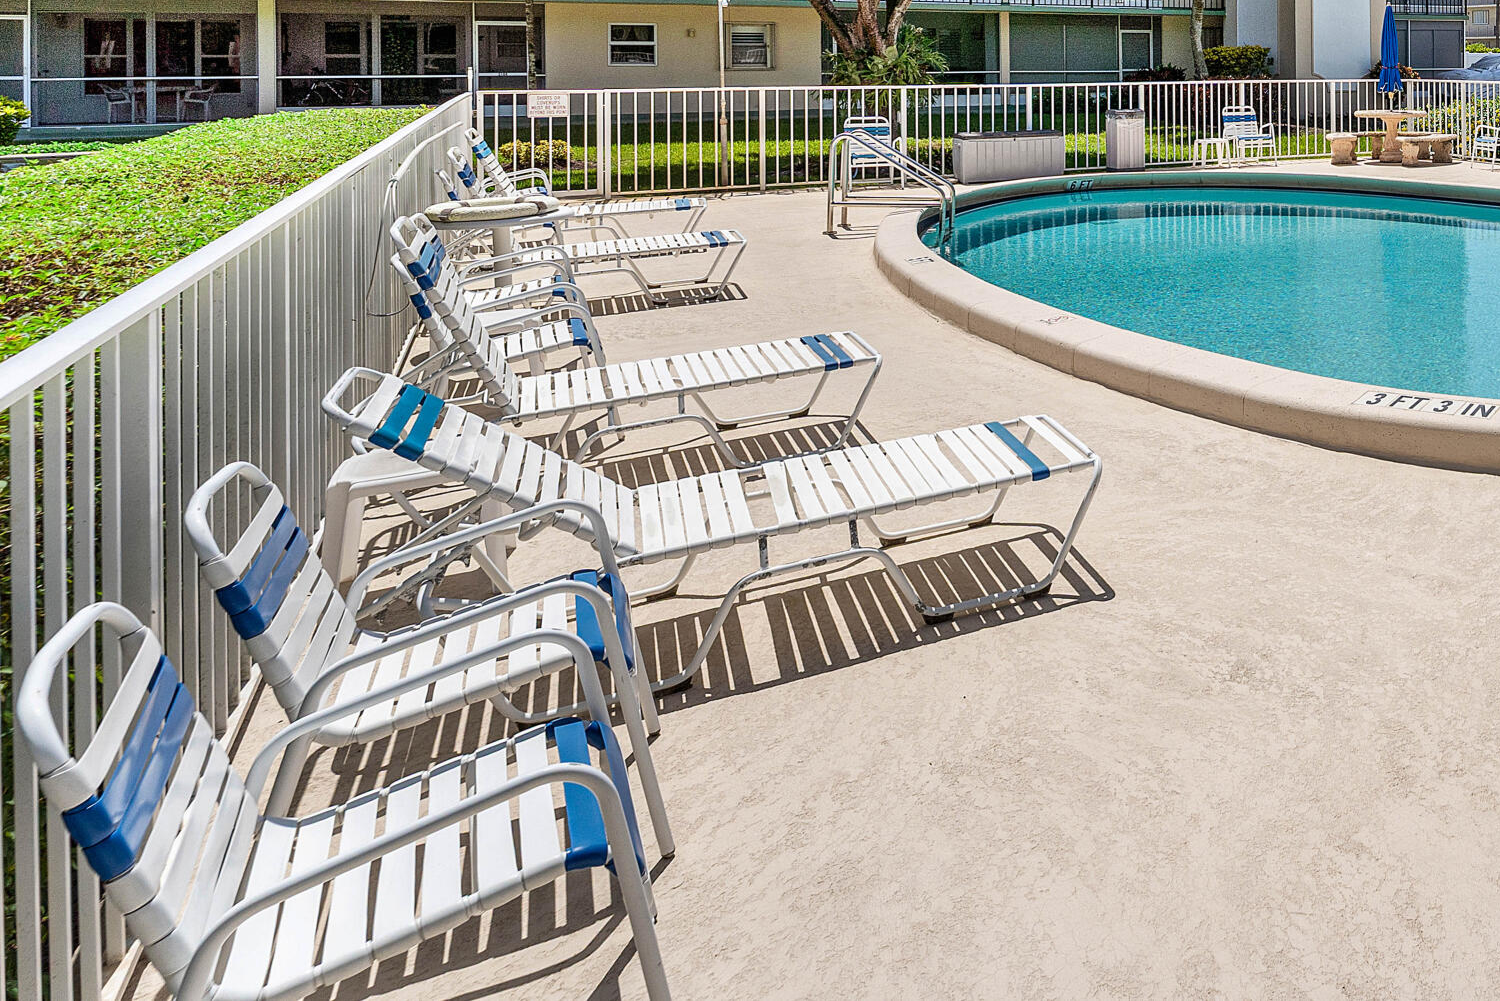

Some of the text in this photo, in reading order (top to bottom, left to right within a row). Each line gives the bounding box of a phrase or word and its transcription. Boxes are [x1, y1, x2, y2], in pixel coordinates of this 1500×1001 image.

[1070, 180, 1092, 190] 6 FT
[1366, 393, 1496, 418] 3 FT 3 IN
